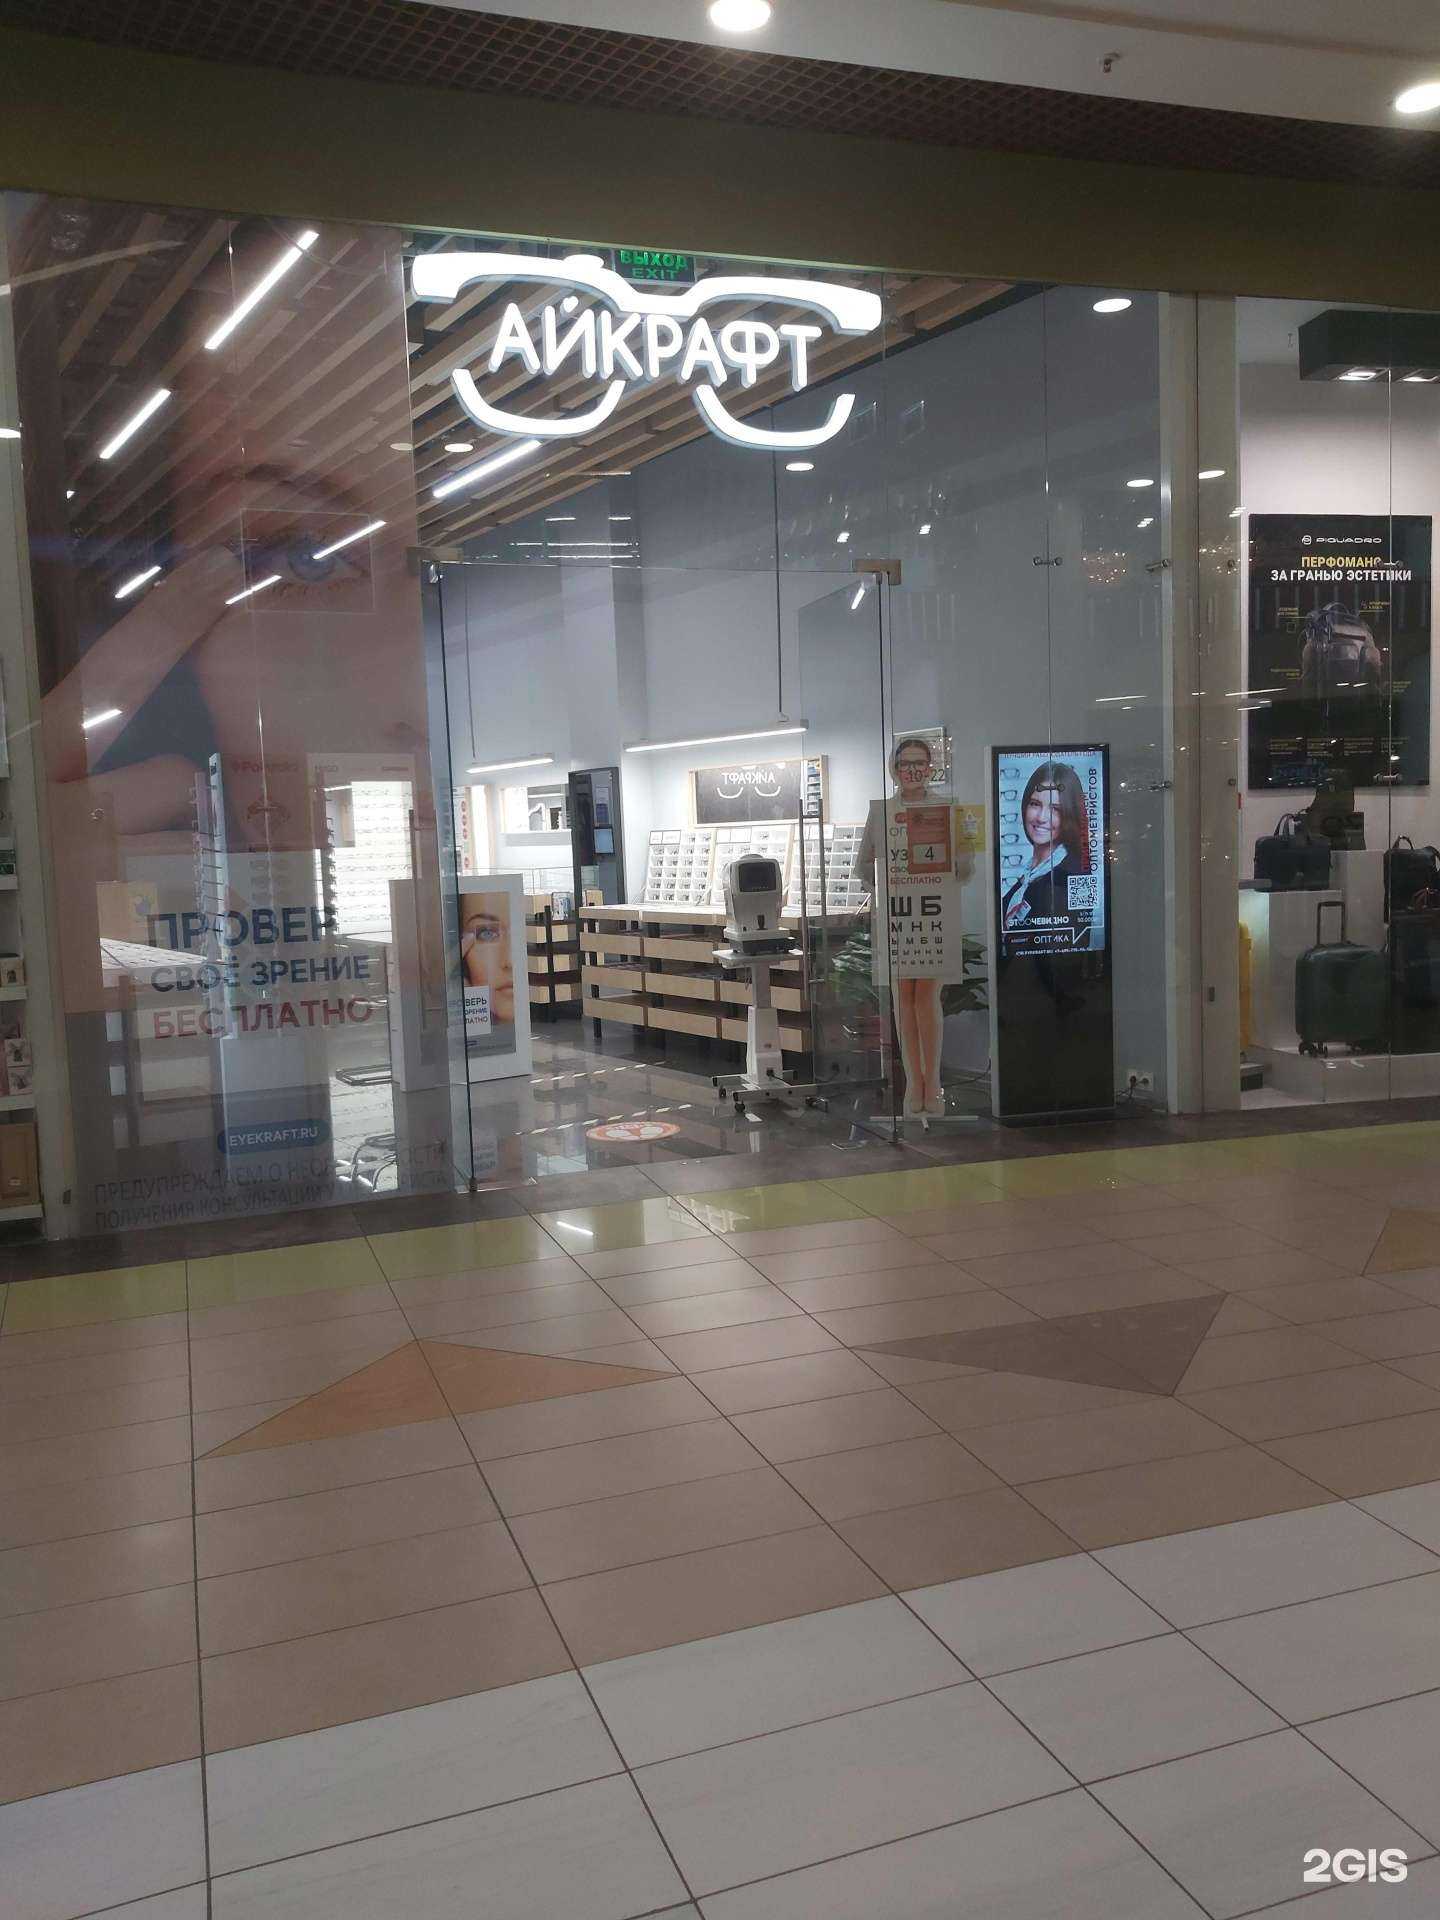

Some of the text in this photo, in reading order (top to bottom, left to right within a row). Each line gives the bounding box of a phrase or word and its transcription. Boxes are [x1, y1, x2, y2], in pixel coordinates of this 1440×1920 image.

[621, 250, 688, 271] ВЫХОД
[632, 267, 678, 280] EXIT
[489, 296, 822, 392] АЙКРАФТ
[1270, 569, 1412, 581] ЗА ГРАНЬЮ ЭСТЕТИКИ
[925, 846, 934, 861] 4
[252, 954, 371, 986] ЗРЕНИЕ
[153, 997, 373, 1040] БЕСПЛАТНО
[229, 1127, 318, 1147] EYEKRAFT.RU
